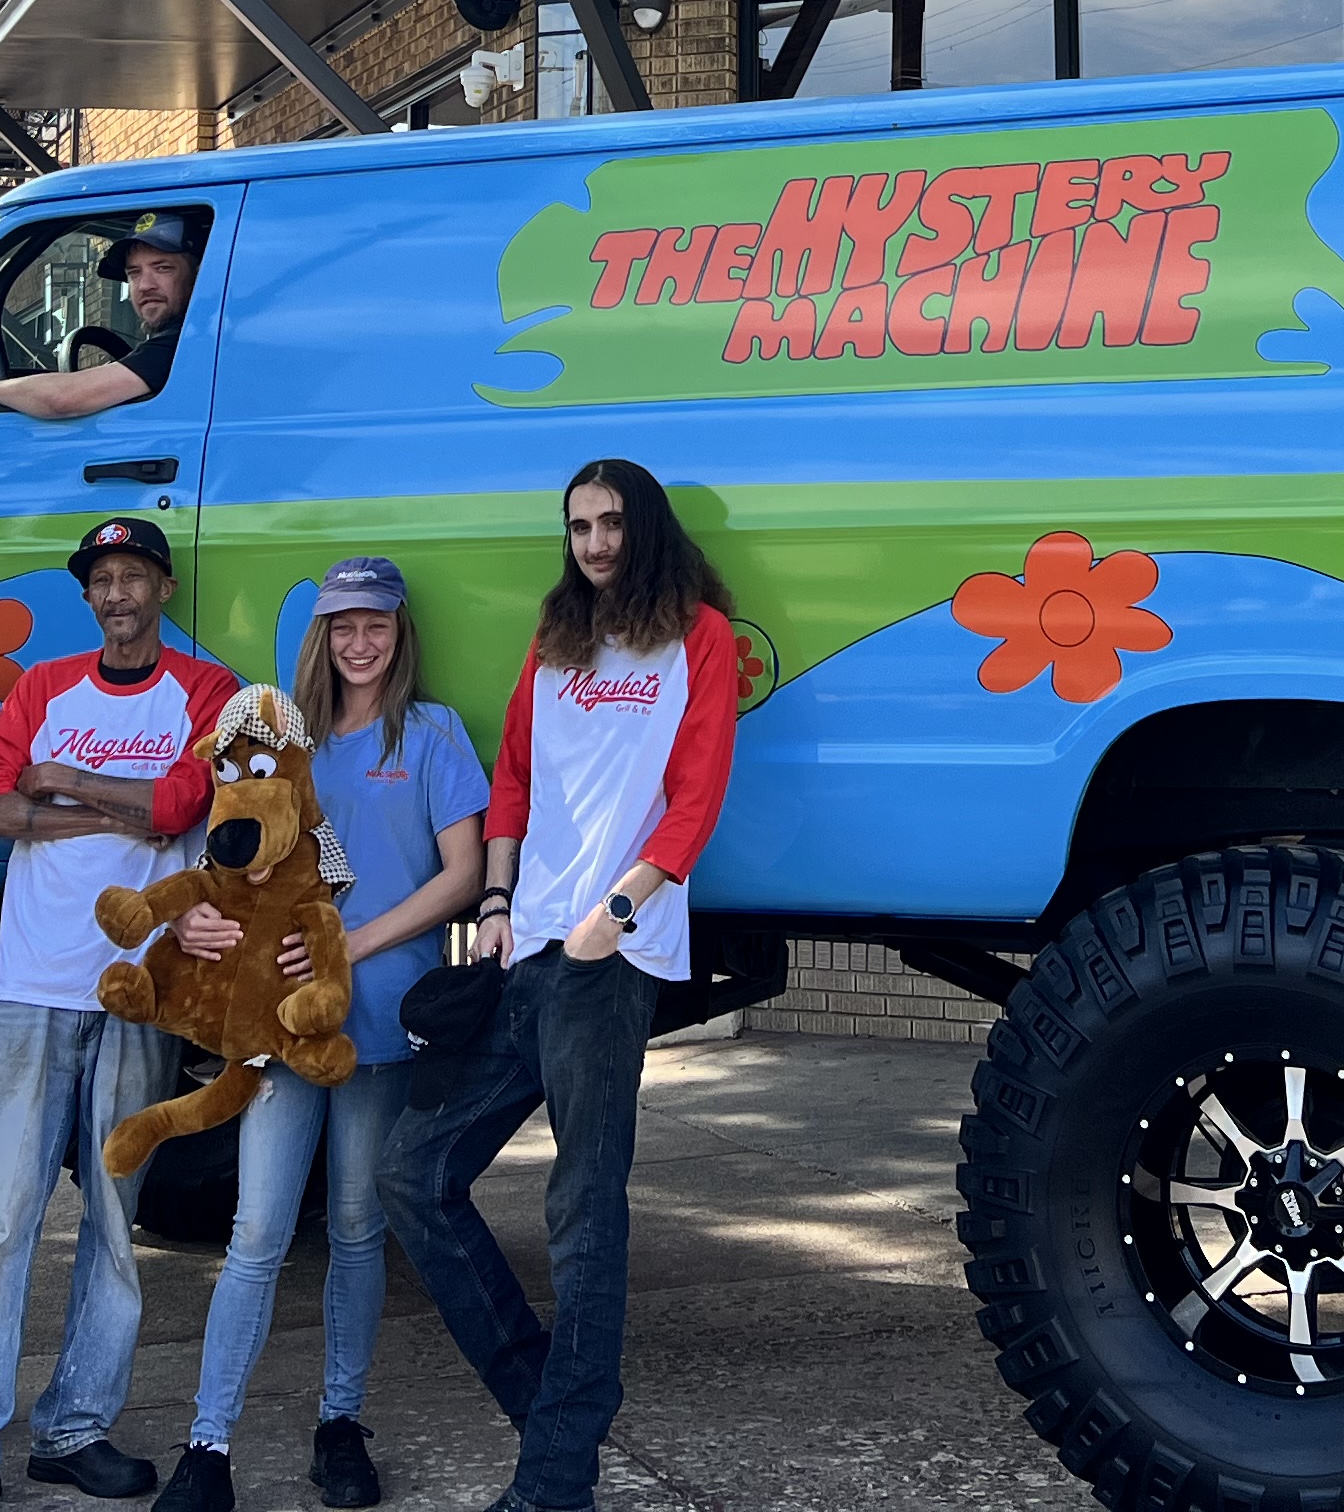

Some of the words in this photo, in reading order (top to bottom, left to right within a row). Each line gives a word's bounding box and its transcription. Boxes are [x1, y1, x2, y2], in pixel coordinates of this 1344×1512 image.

[590, 225, 766, 309] THE
[741, 152, 1231, 301] MYSTERY
[721, 205, 1221, 364] MACHINE
[558, 666, 661, 713] Mugshots
[50, 727, 176, 770] Mugshots
